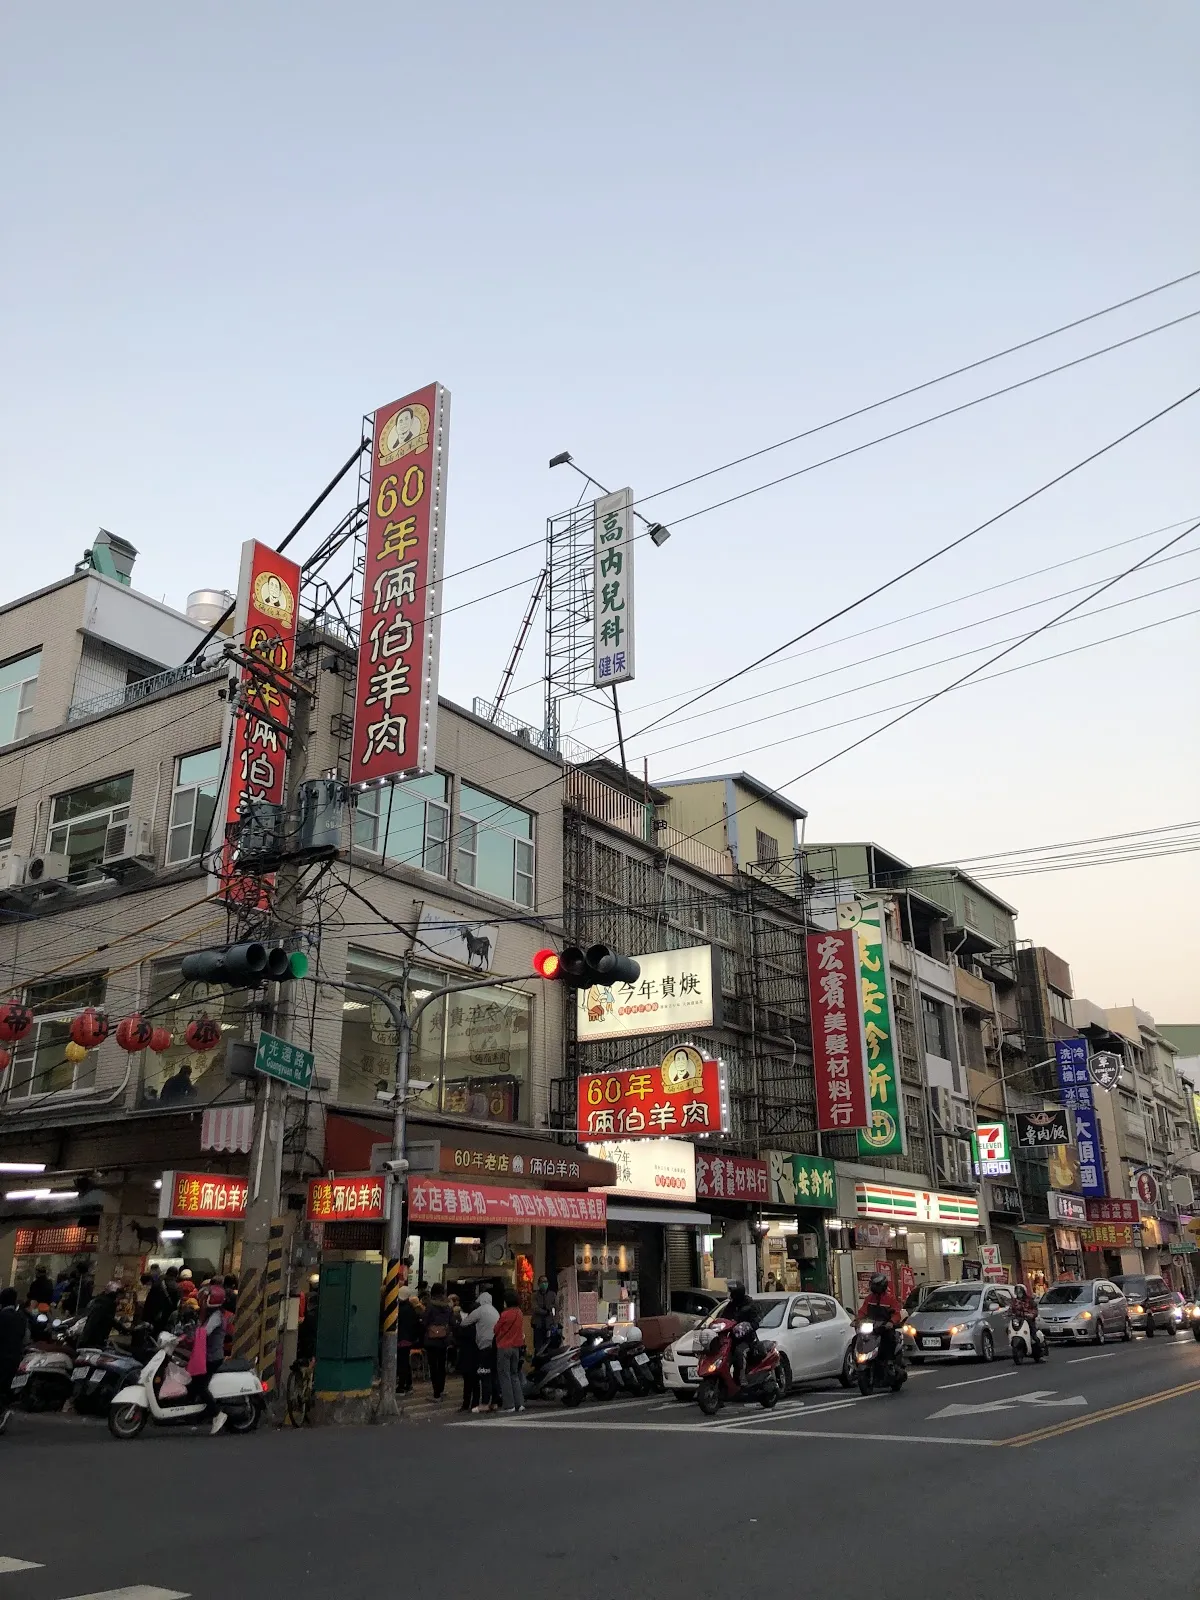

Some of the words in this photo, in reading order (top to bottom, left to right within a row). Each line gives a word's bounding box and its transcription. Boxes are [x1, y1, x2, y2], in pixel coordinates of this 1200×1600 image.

[600, 511, 625, 648] 高內兒科
[598, 651, 626, 678] 健保
[816, 935, 854, 1125] 宏賓美髮材料行
[268, 1040, 305, 1068] 光遠路
[587, 1073, 654, 1105] 60年
[978, 1128, 1000, 1159] 7
[454, 1149, 510, 1172] 60年老店
[787, 1166, 833, 1199] 安診所
